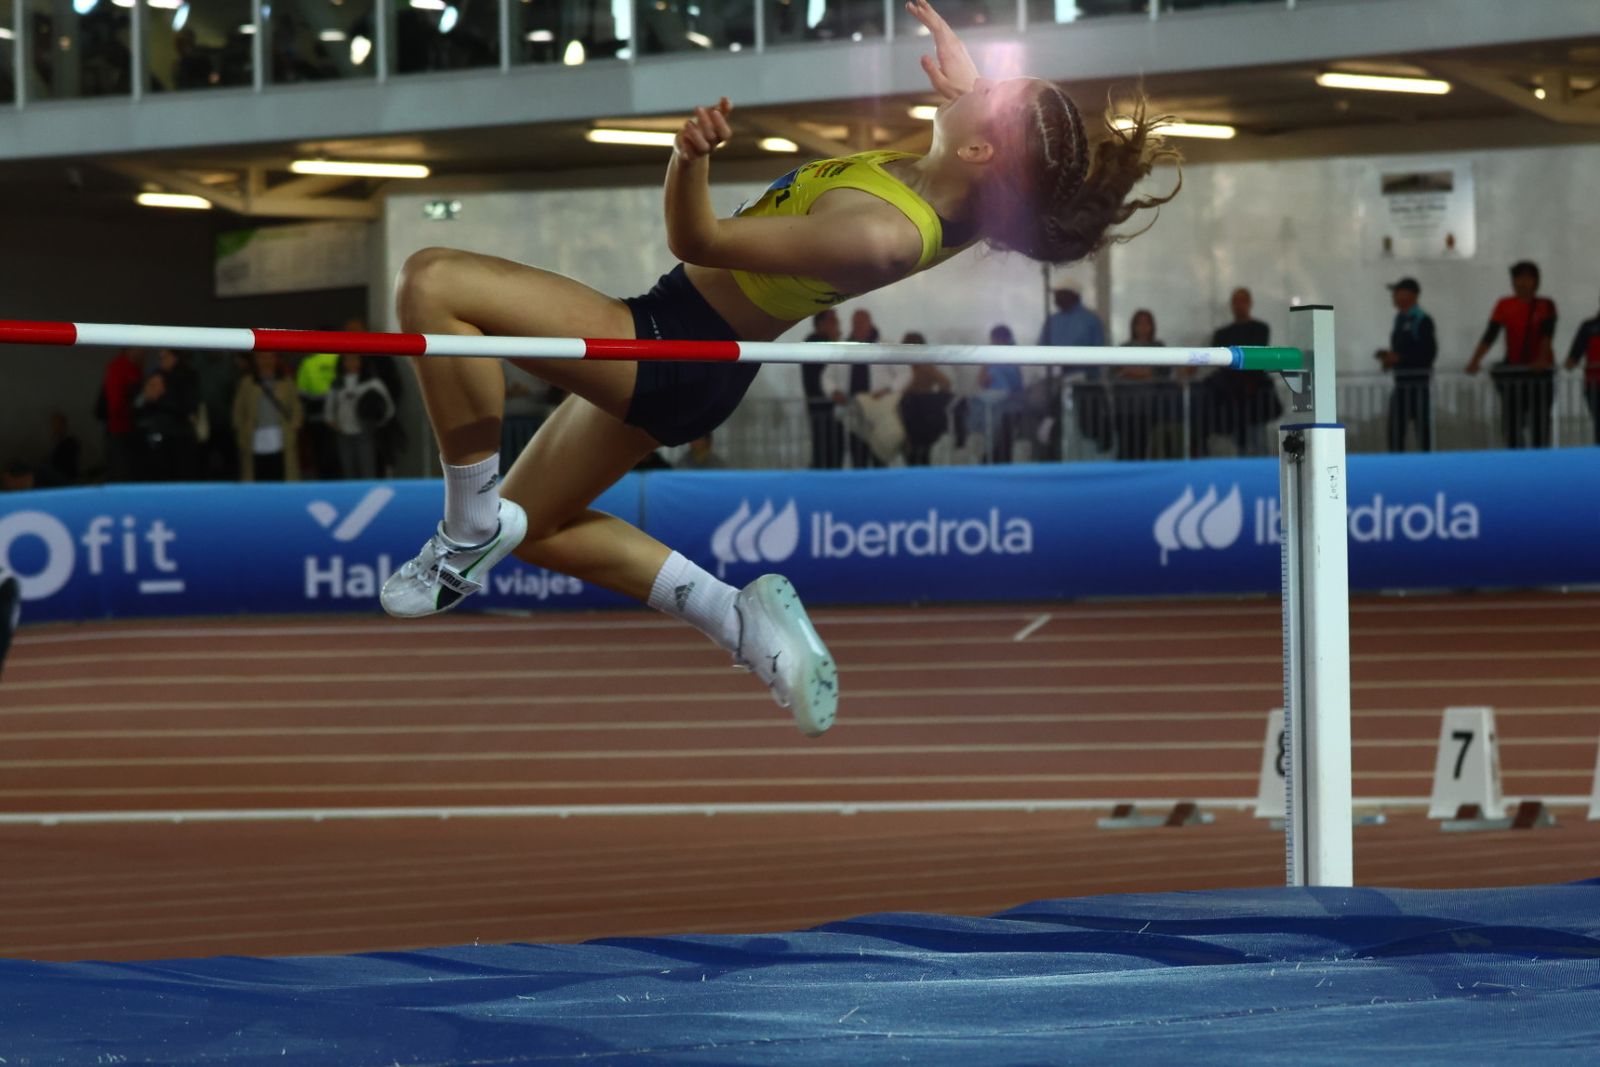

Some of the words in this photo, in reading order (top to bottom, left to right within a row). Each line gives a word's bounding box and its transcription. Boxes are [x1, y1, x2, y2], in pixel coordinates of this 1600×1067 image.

[810, 507, 1033, 558] Iberdrola
[1255, 492, 1480, 546] Ibdrola
[81, 515, 178, 575] fit
[494, 567, 584, 599] viajes
[1452, 731, 1475, 780] 7
